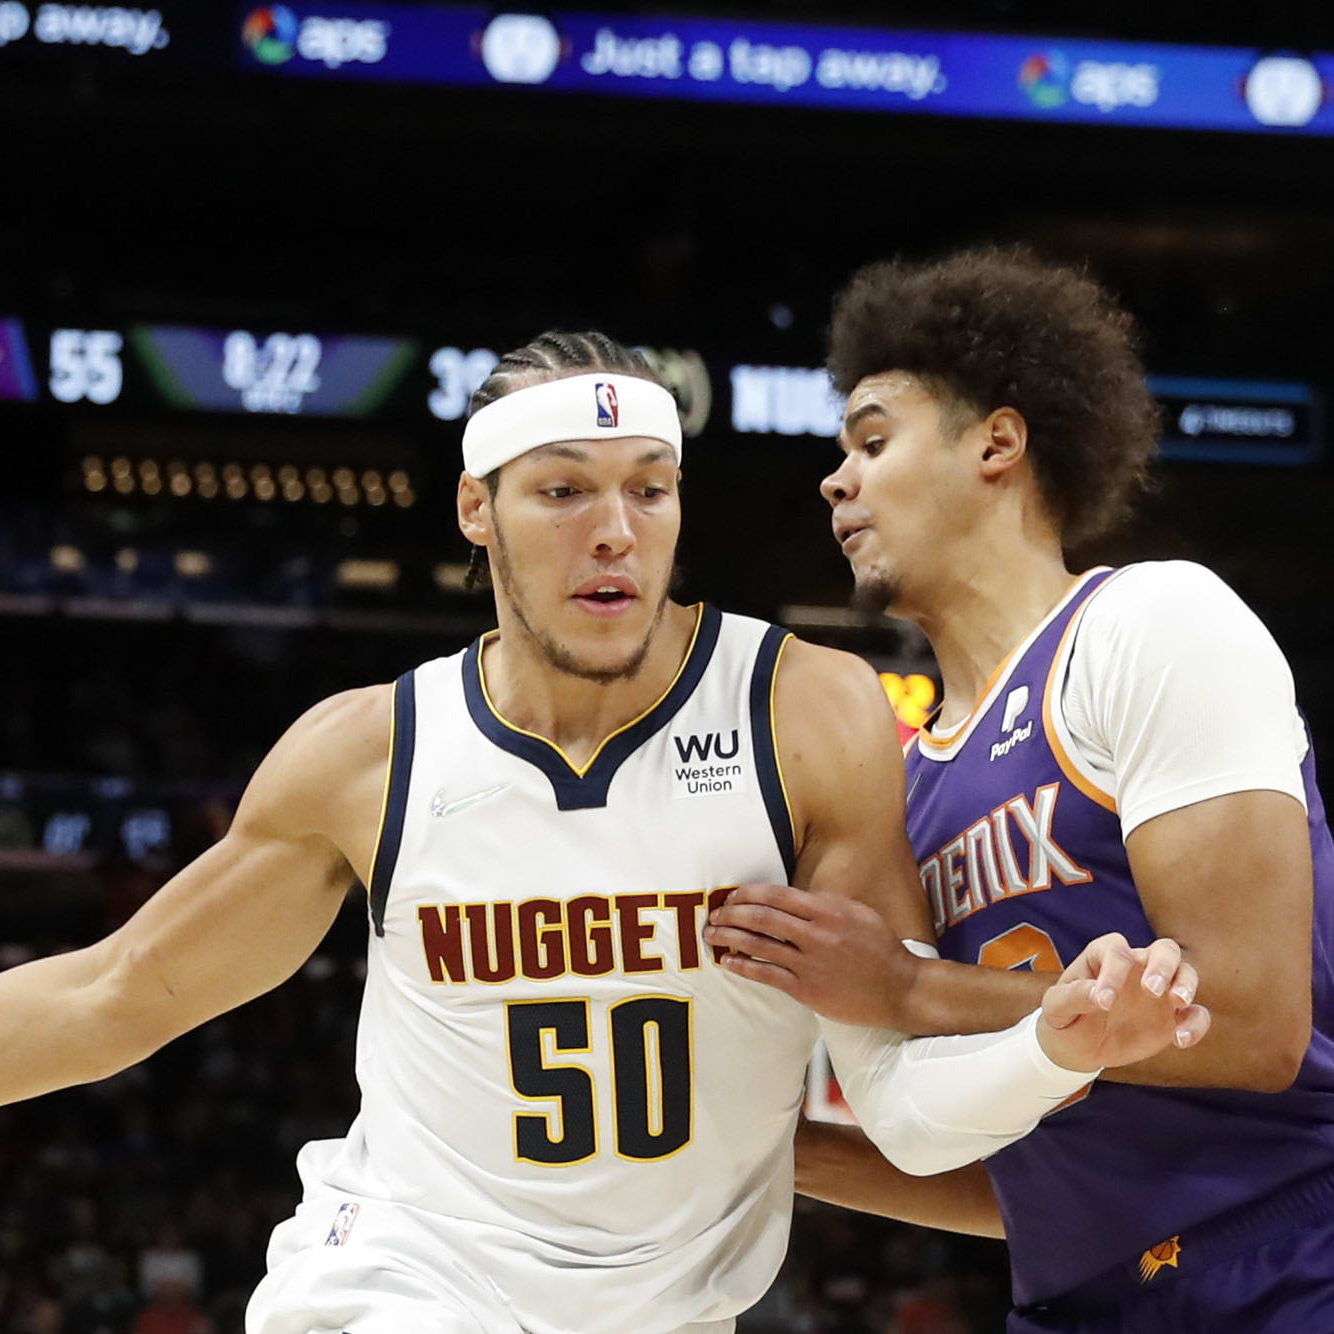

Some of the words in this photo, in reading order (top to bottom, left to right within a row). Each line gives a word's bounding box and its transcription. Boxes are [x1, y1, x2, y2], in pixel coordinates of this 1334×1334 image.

[581, 28, 682, 79] Just
[687, 41, 724, 81] a
[728, 37, 812, 92] tap
[816, 48, 947, 100] away.
[1070, 60, 1159, 112] aps
[49, 329, 123, 404] 55
[674, 729, 739, 763] WU
[989, 720, 1032, 762] PayPal
[675, 765, 741, 780] Western
[687, 779, 732, 793] Union
[504, 994, 693, 1168] 50
